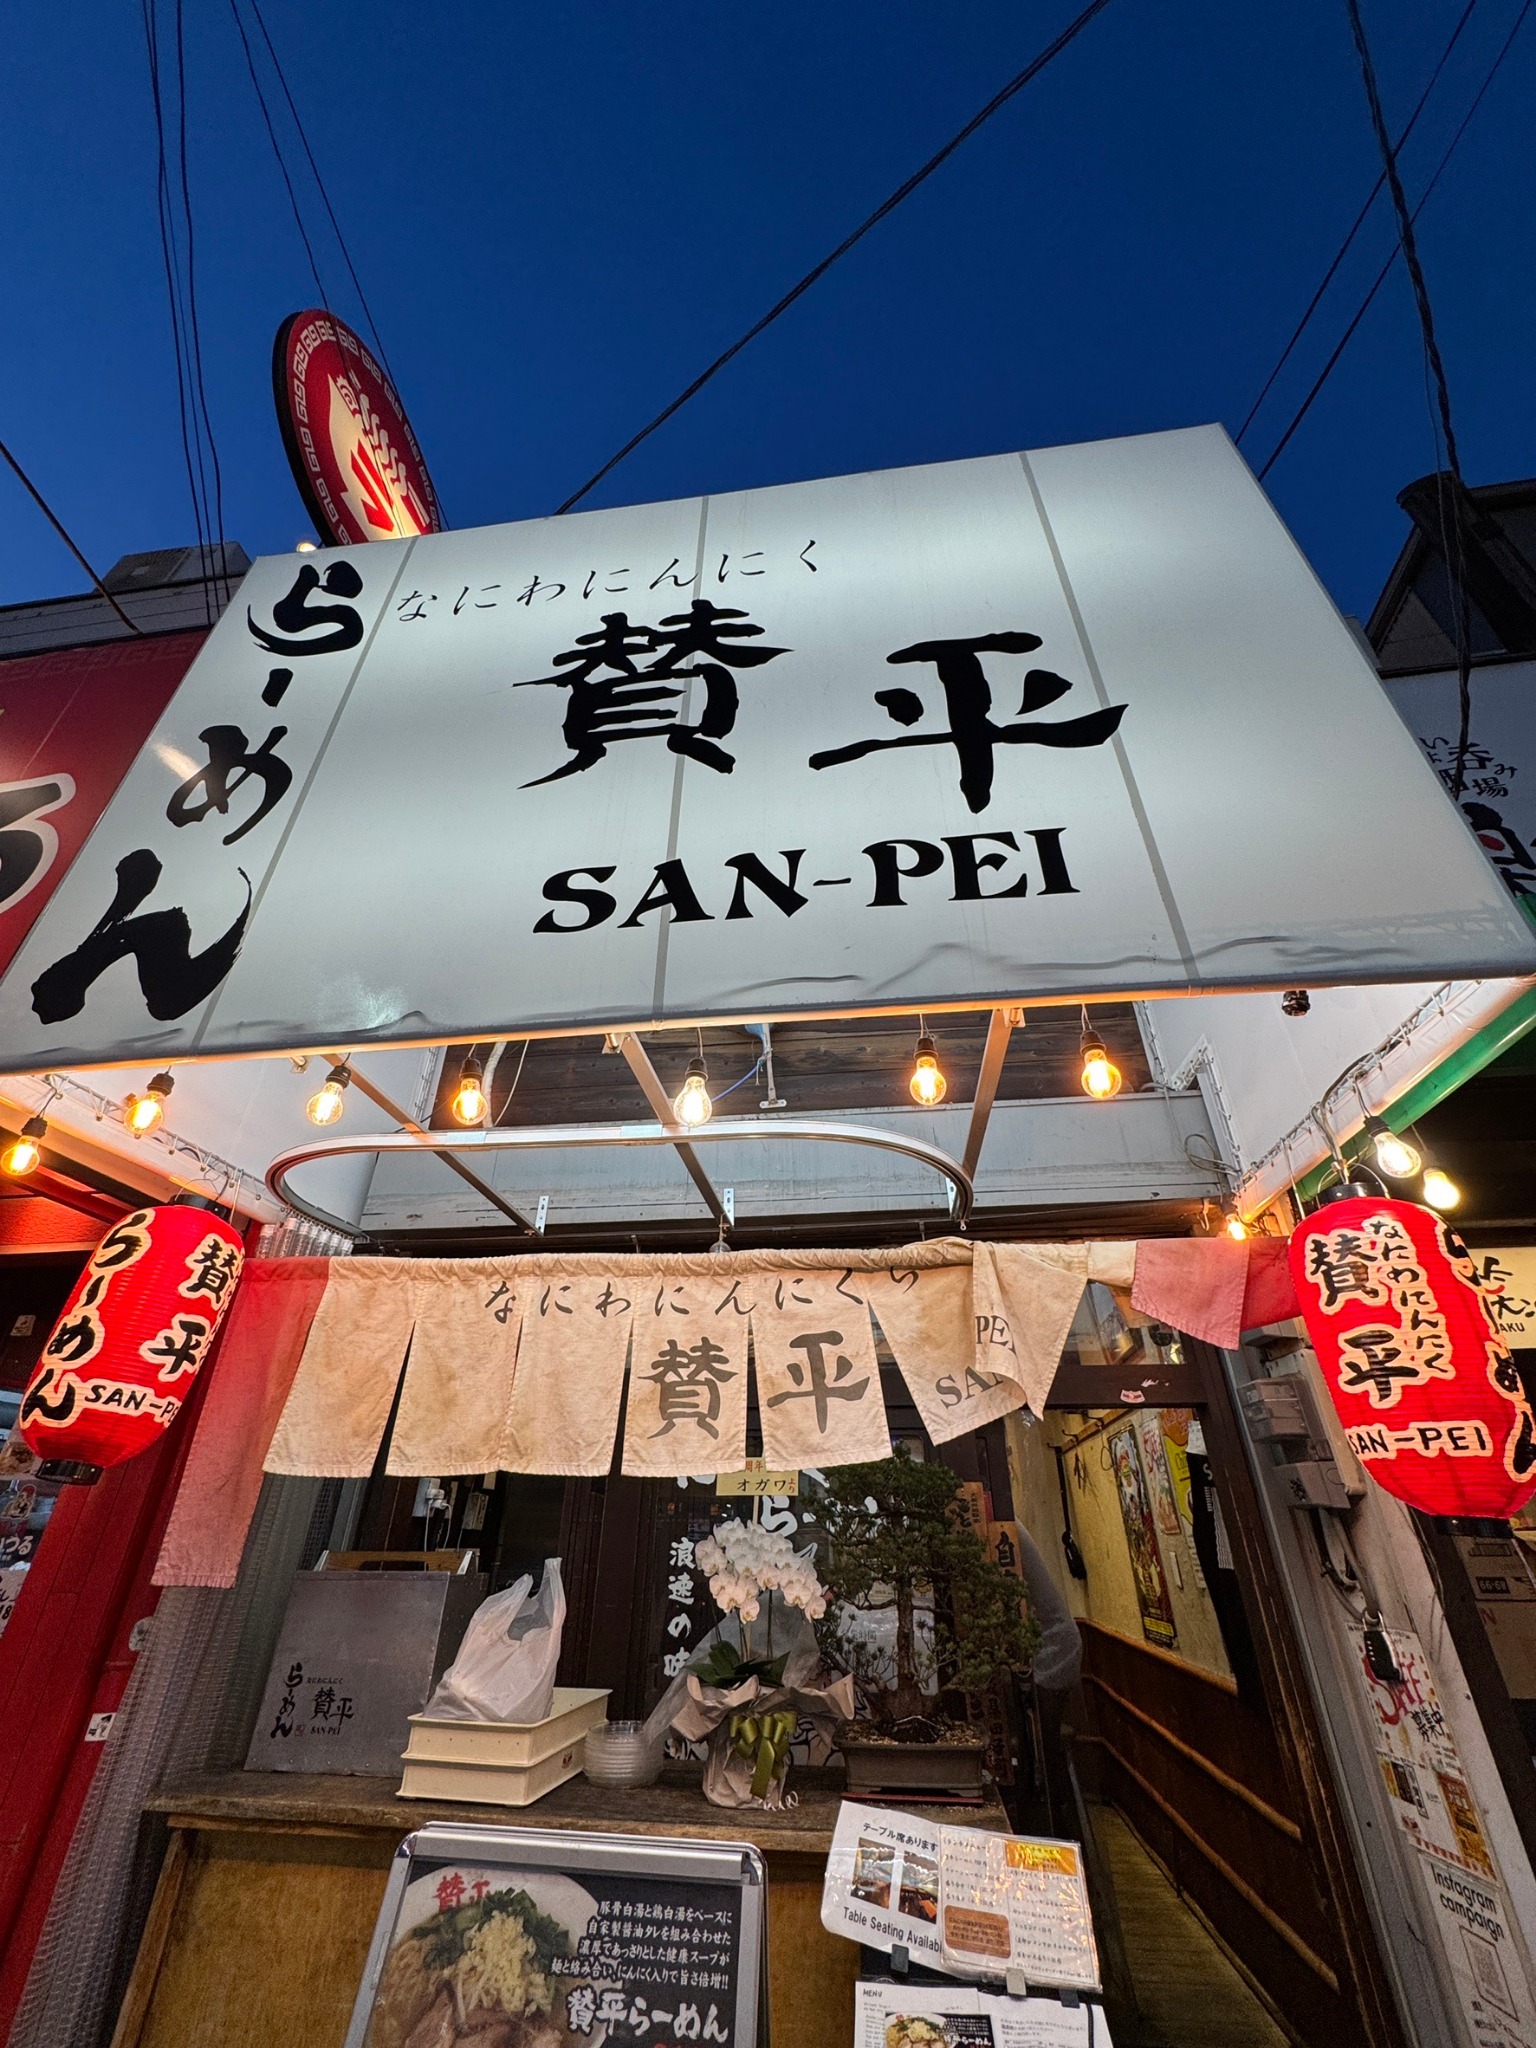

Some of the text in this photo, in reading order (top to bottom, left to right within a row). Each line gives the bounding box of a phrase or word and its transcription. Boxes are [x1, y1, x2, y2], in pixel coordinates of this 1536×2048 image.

[397, 540, 820, 622] なにわにんにく
[513, 598, 1129, 814] 賛平
[31, 561, 364, 1025] らーめん
[534, 827, 1081, 933] SAN-PEI
[22, 1212, 148, 1422] らーめん
[148, 1239, 238, 1375] 賛平
[1310, 1233, 1420, 1402] 賛平
[1369, 1220, 1449, 1373] なにわにんにく
[637, 1330, 871, 1441] 賛平
[737, 1478, 787, 1492] オガワ
[270, 1662, 303, 1738] らーめん
[310, 1686, 354, 1726] 賛平
[863, 1822, 938, 1851] テーブル席あります
[843, 1906, 867, 1926] Table
[870, 1916, 903, 1941] Seating
[1431, 1863, 1498, 1914] Instagram
[1440, 1893, 1505, 1942] campaign
[567, 1987, 729, 2043] 賛平らーめん
[863, 1988, 883, 1998] MENU
